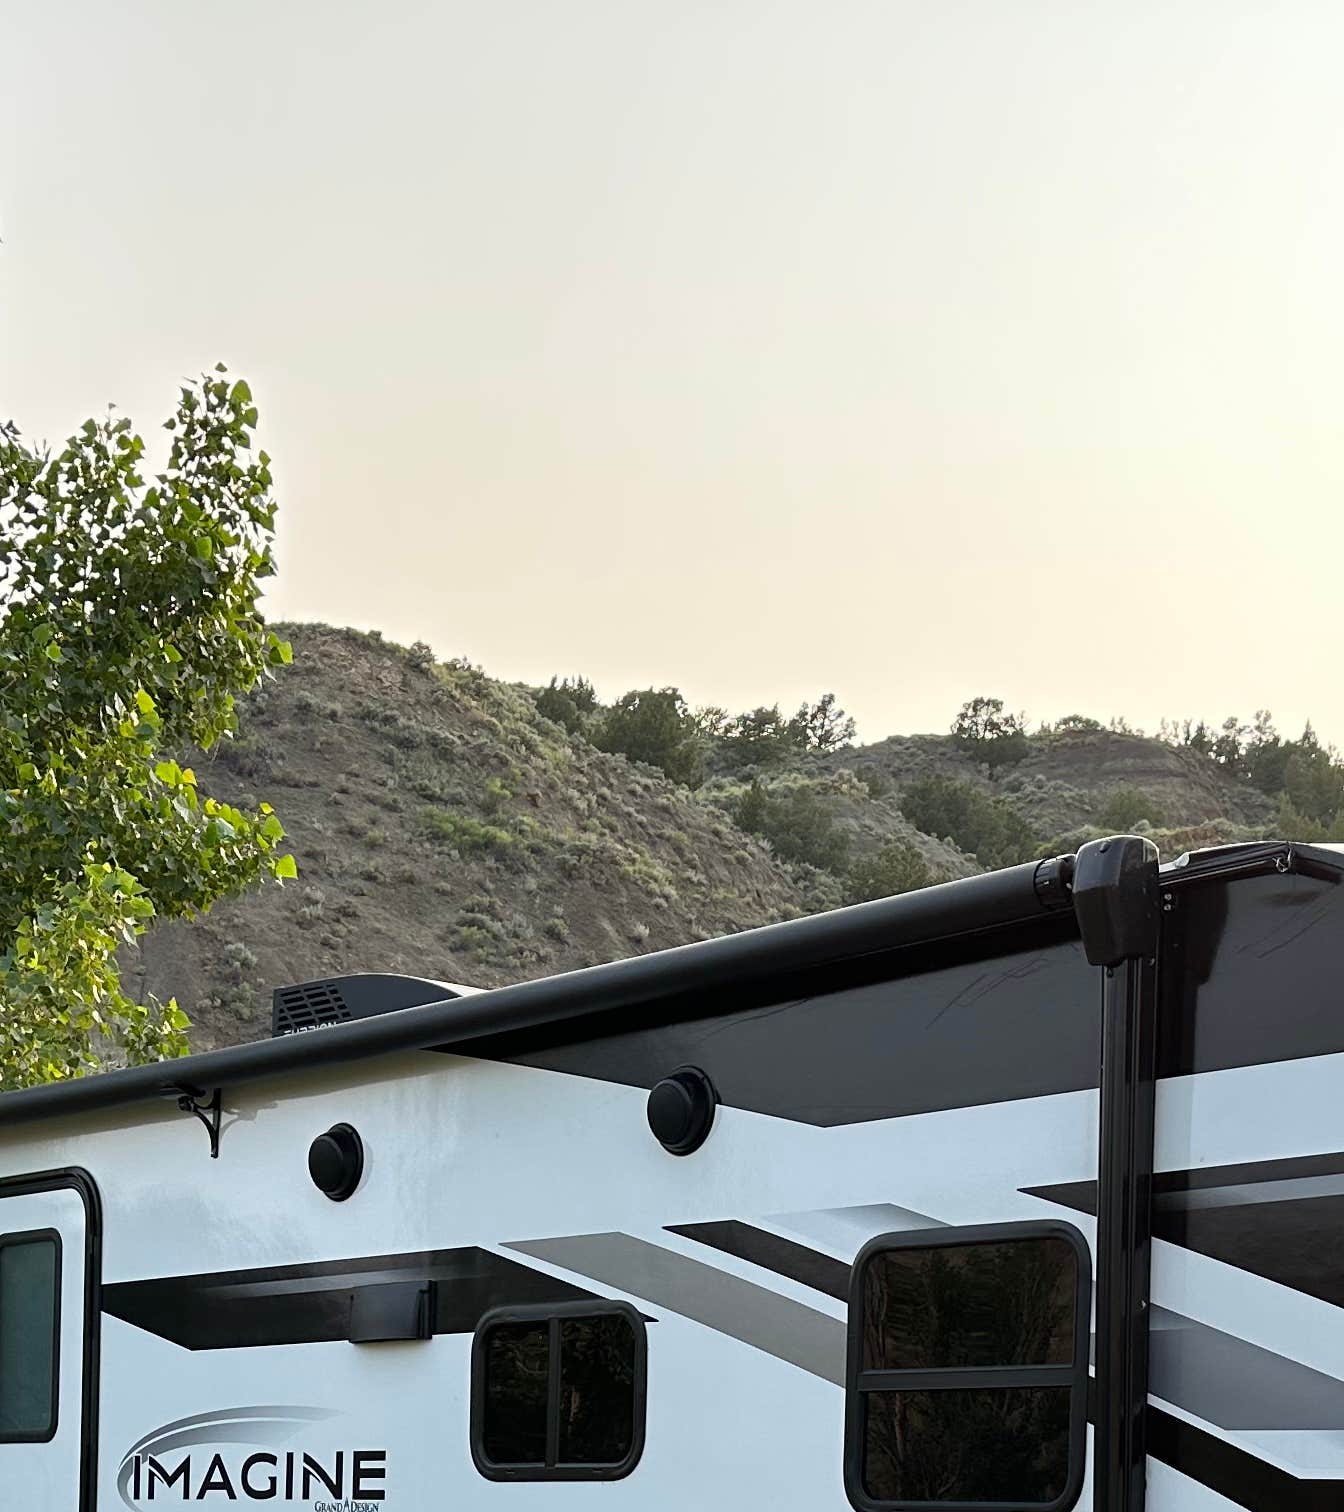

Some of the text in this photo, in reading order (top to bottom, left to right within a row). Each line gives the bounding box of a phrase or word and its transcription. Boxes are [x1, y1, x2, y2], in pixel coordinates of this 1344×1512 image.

[133, 1450, 386, 1500] IMAGINE
[315, 1500, 379, 1512] GRAND DESIGN
